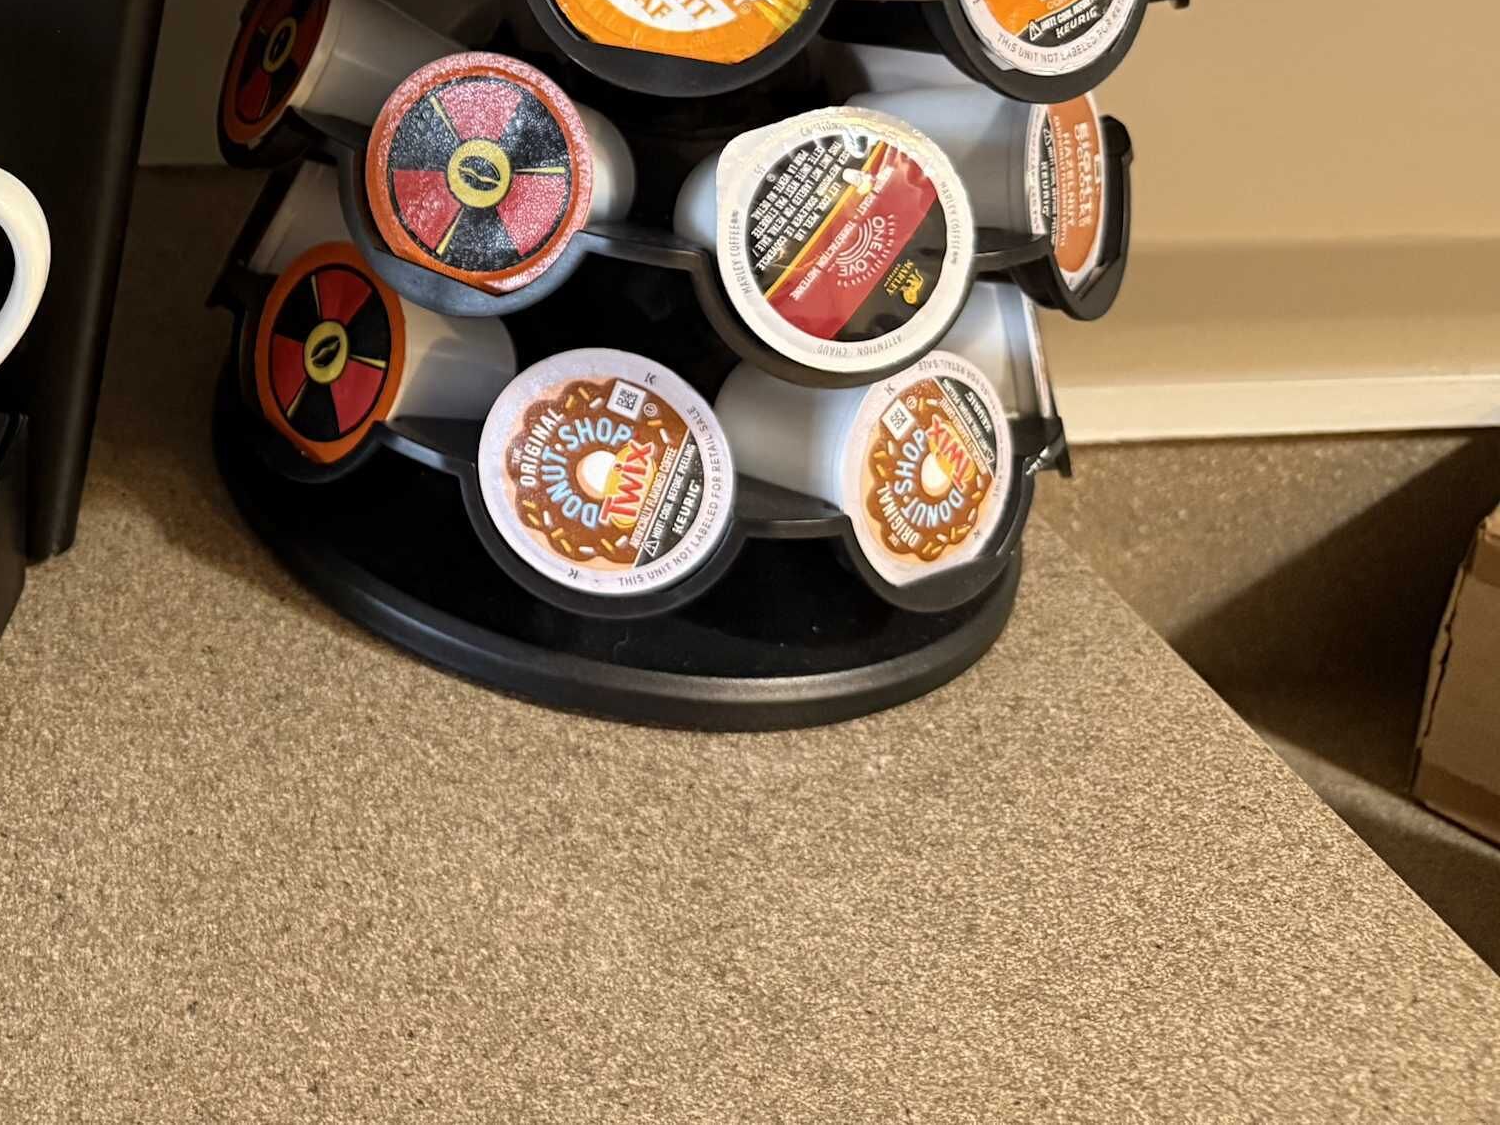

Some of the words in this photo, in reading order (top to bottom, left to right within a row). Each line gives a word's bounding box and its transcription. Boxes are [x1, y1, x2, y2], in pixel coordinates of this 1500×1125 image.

[1056, 6, 1099, 38] KEURIG
[786, 164, 797, 174] LA
[1062, 131, 1078, 227] HAZELNUT
[791, 179, 813, 205] LABELED
[827, 181, 840, 195] LET
[802, 211, 818, 229] PEEL
[869, 215, 886, 252] ONE
[837, 251, 877, 278] LOVE
[887, 259, 914, 296] MARLEY
[686, 405, 710, 433] SALE
[964, 391, 992, 434] KEURIG
[519, 407, 564, 487] ORIGINAL
[558, 417, 632, 451] SHOP
[658, 445, 678, 473] COFFEE
[706, 436, 722, 473] RETAIL
[894, 428, 929, 495] SHOP
[542, 447, 599, 528] DONUT
[651, 517, 665, 541] HOT!
[659, 501, 673, 521] COOL
[666, 475, 684, 503] BEFORE
[677, 442, 697, 477] PEELING
[711, 476, 723, 501] FOR
[672, 479, 700, 535] KEURIG
[876, 480, 924, 549] ORIGINAL
[900, 489, 966, 528] DONUT
[690, 501, 719, 551] LABELED
[648, 561, 672, 581] UNIT
[672, 546, 692, 567] NOT
[617, 571, 645, 588] THIS
